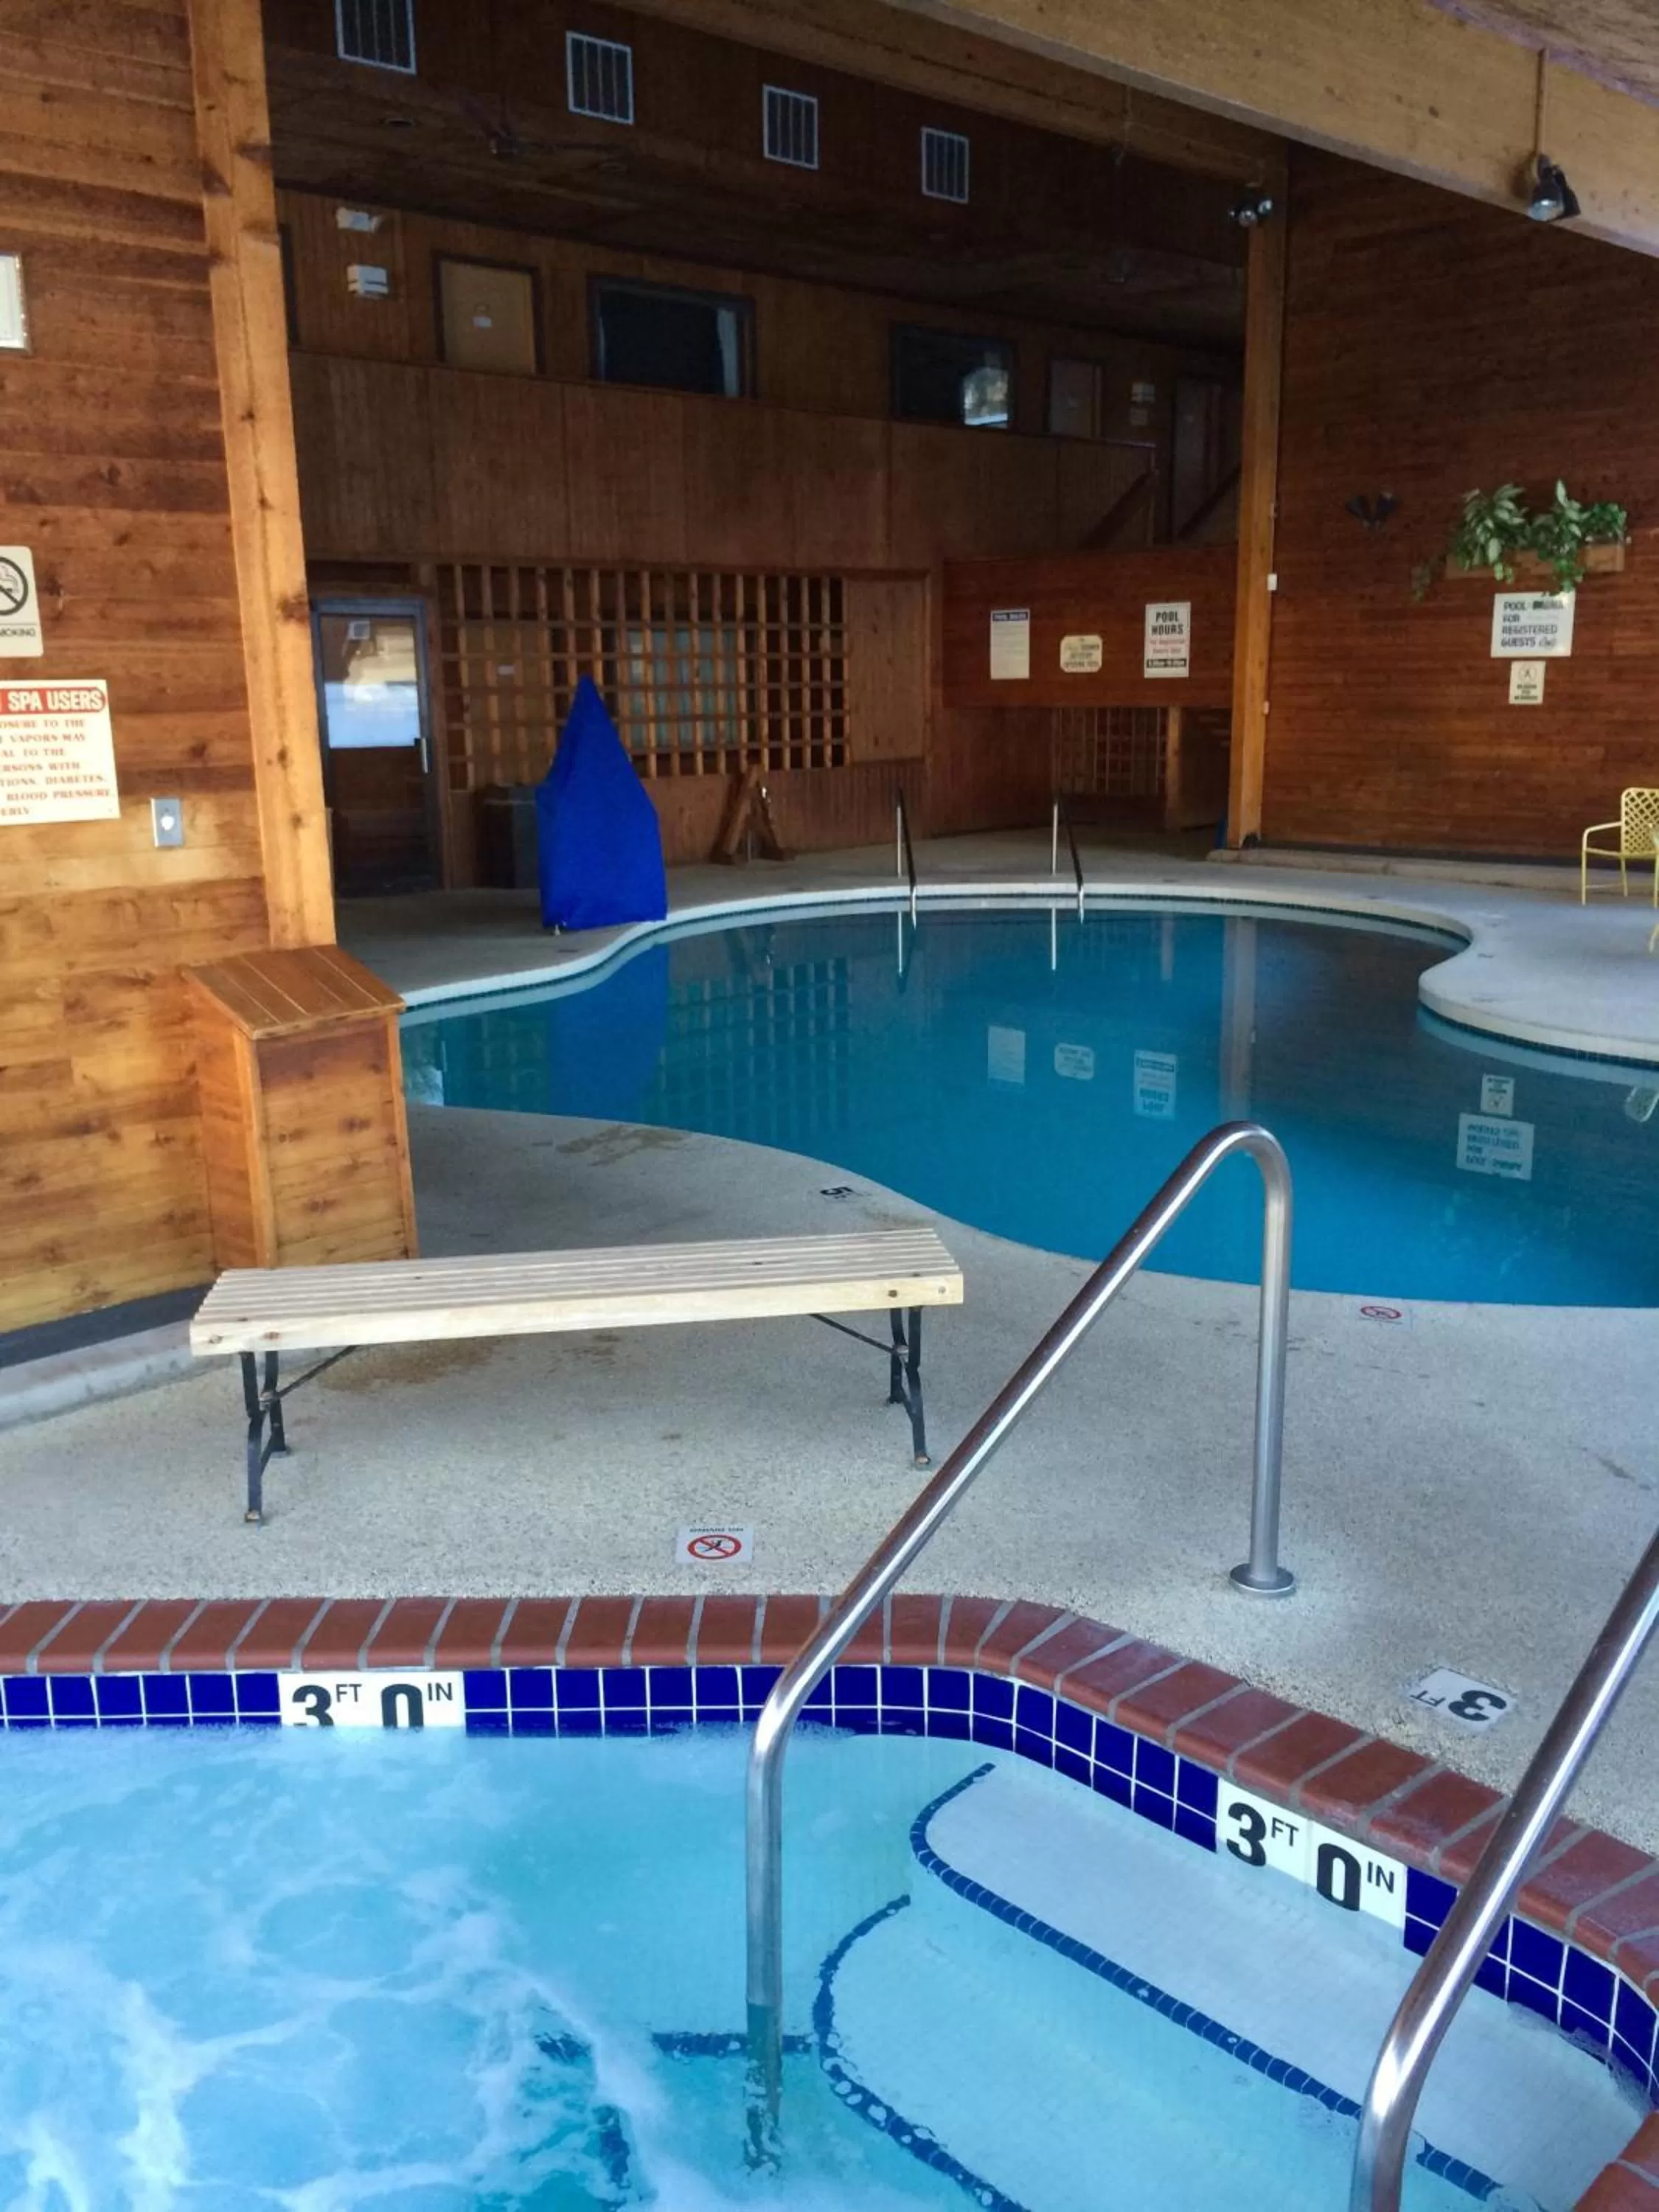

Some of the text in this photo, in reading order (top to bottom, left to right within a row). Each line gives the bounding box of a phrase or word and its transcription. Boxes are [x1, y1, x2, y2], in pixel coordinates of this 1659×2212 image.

[1155, 611, 1180, 622] POOL
[1152, 624, 1183, 636] HOURS
[1502, 625, 1558, 635] REGISTERED
[1501, 636, 1536, 647] GUESTS
[7, 689, 102, 712] SPA USERS
[44, 720, 59, 728] TO
[65, 719, 86, 728] THE
[10, 734, 58, 743] VAPORS
[63, 734, 86, 742] MAY
[24, 748, 38, 757] TO
[44, 748, 66, 757] THE
[49, 762, 80, 771] WITH
[7, 792, 48, 801] BLOOD
[292, 1684, 334, 1726] 3
[336, 1683, 362, 1703] FT
[427, 1682, 453, 1701] IN
[1409, 1689, 1508, 1722] 3 FT
[1226, 1801, 1395, 1912] 3 FT 0 IN
